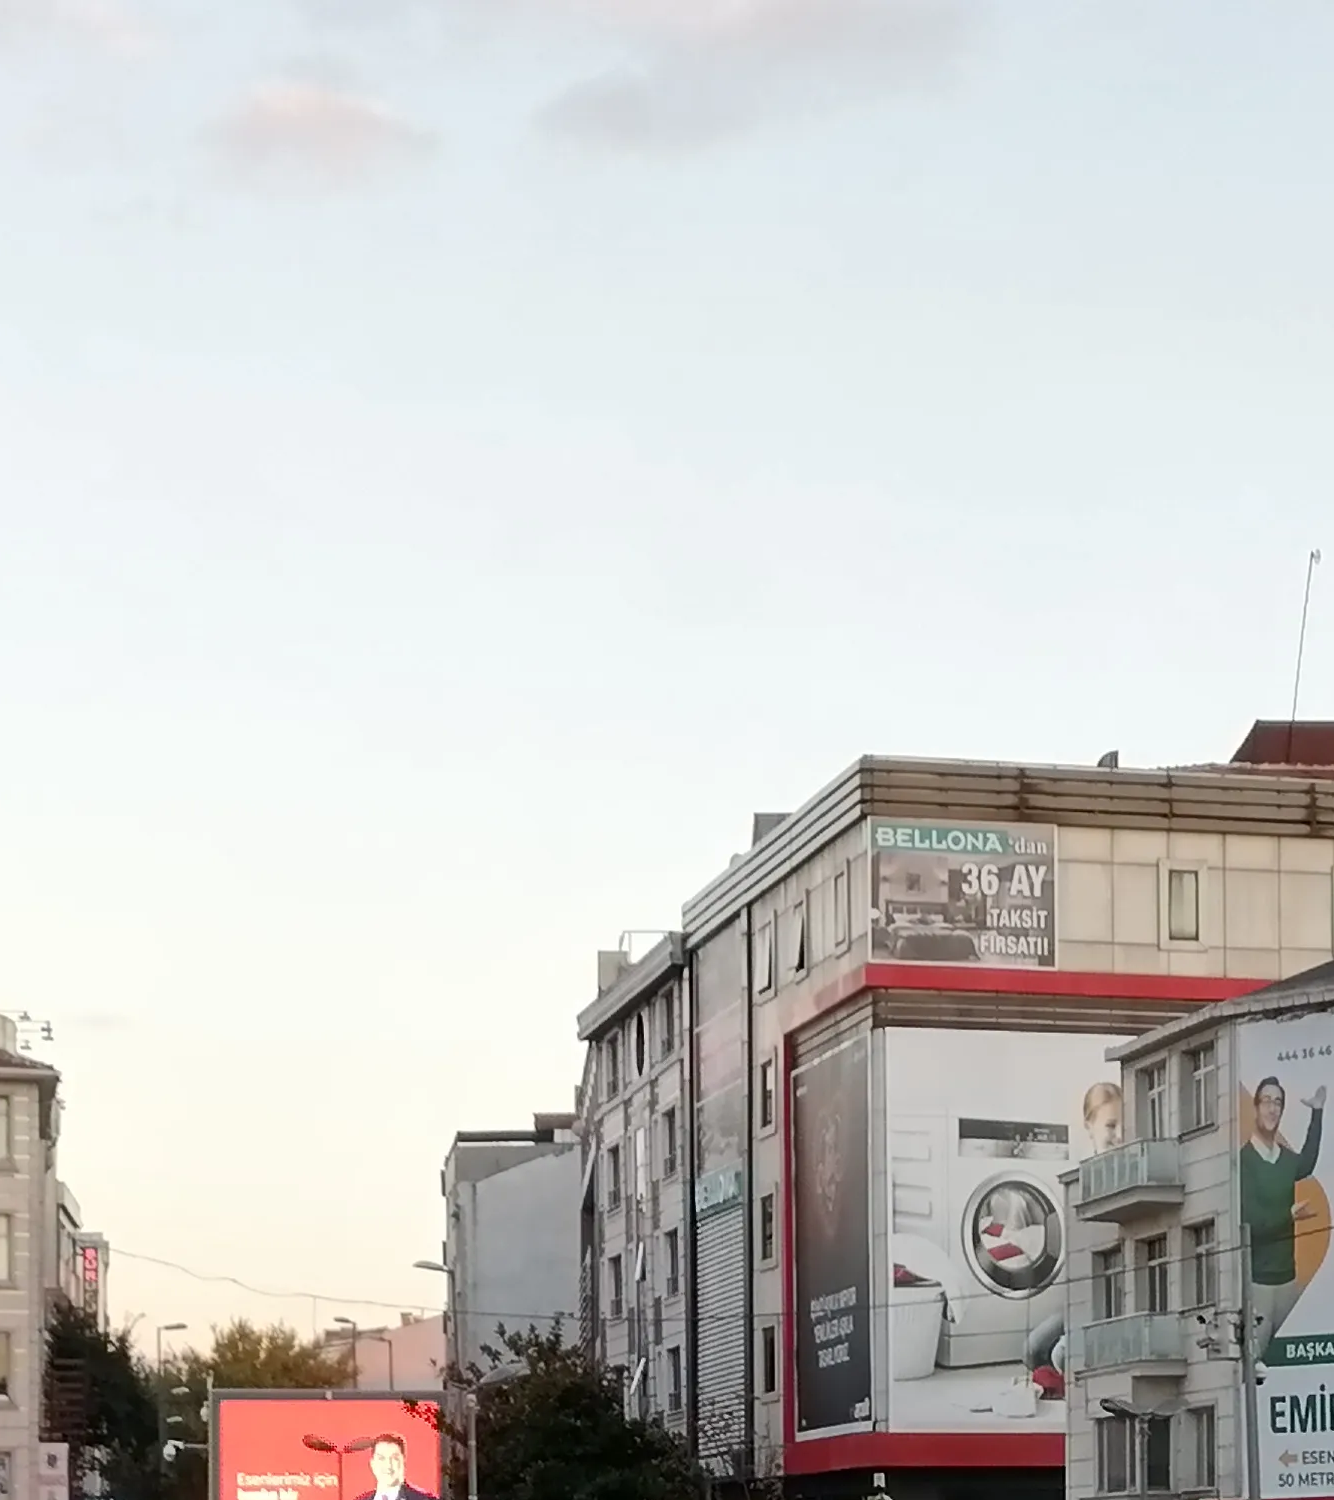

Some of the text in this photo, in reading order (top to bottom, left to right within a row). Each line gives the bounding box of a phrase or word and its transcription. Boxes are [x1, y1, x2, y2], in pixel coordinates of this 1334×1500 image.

[876, 827, 1003, 853] BELLONA
[961, 863, 1047, 897] 36 AY
[989, 906, 1048, 929] TAKSİT
[1278, 1051, 1299, 1062] 444
[1302, 1048, 1315, 1059] 36
[1319, 1045, 1332, 1056] 46
[1278, 1473, 1294, 1487] 50
